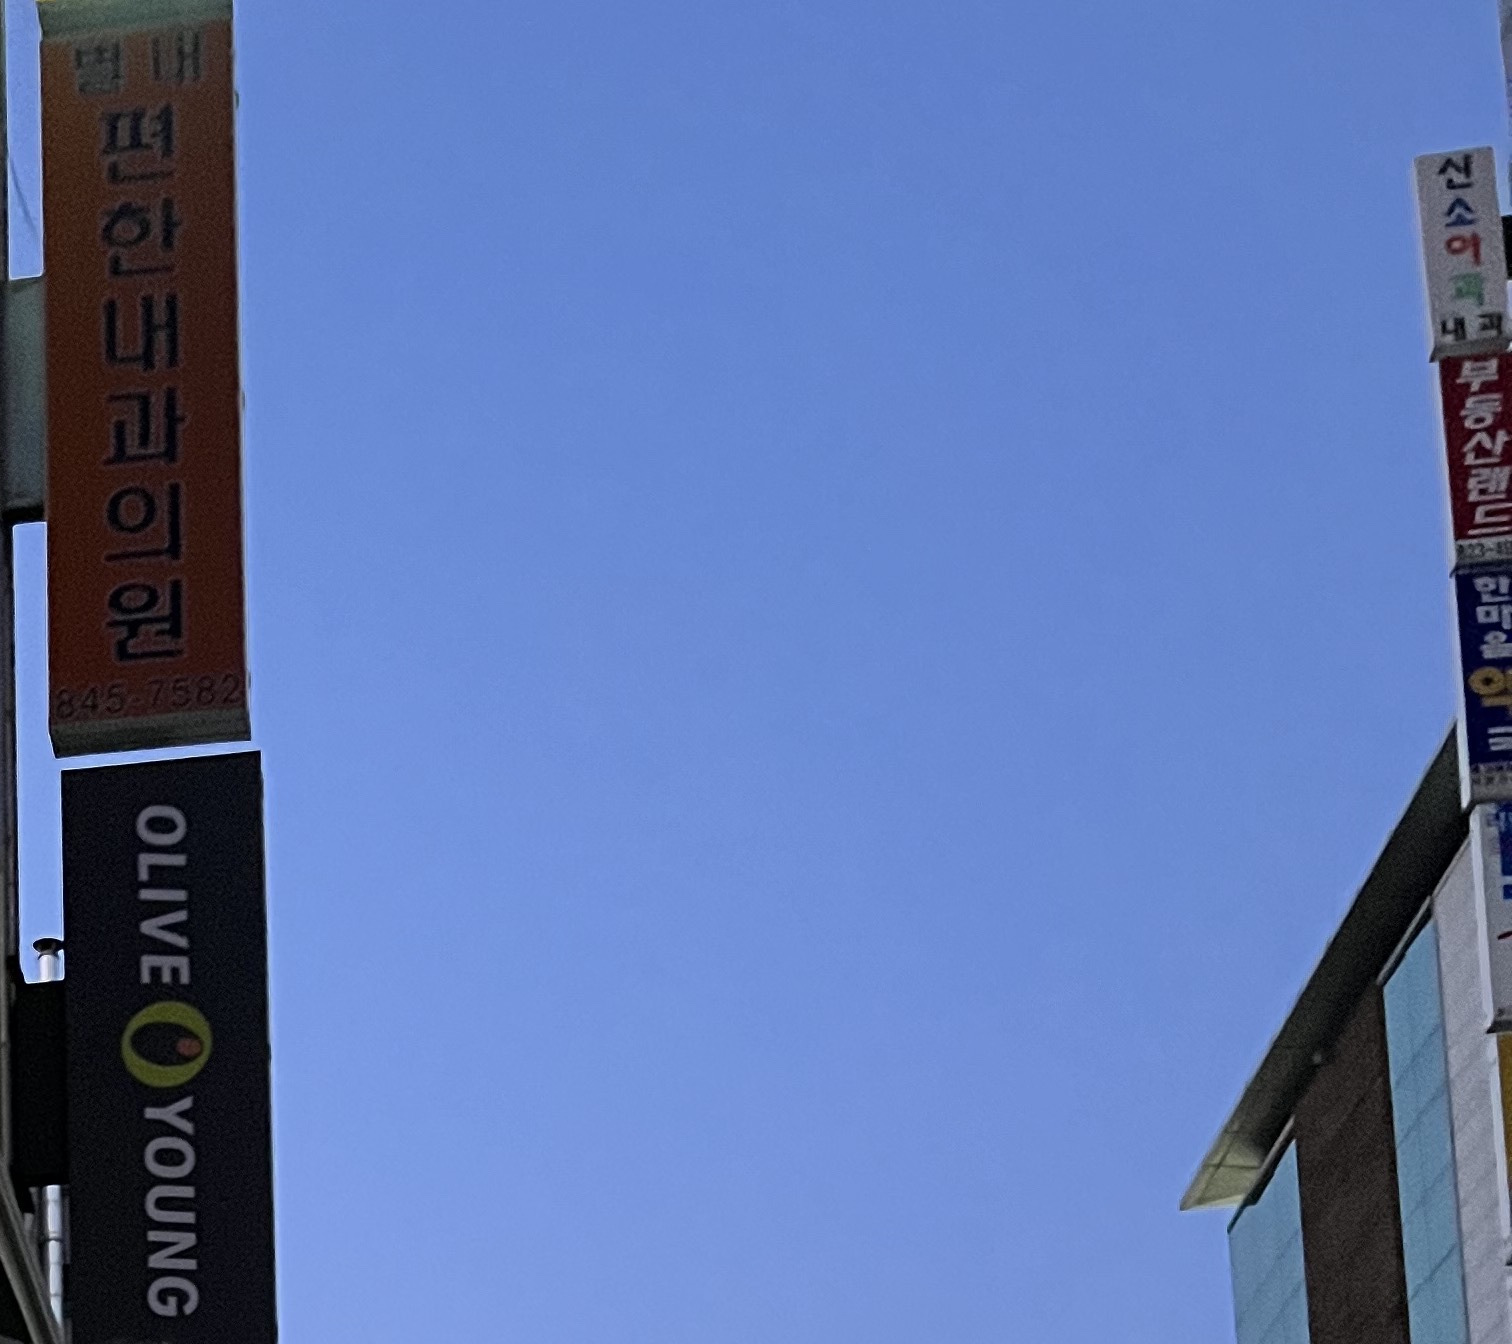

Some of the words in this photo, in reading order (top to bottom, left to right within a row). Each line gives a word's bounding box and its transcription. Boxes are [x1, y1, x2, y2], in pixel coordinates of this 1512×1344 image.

[99, 106, 185, 663] 편한내과의원
[136, 804, 189, 985] OLIVE
[143, 1096, 200, 1317] YOUNG
